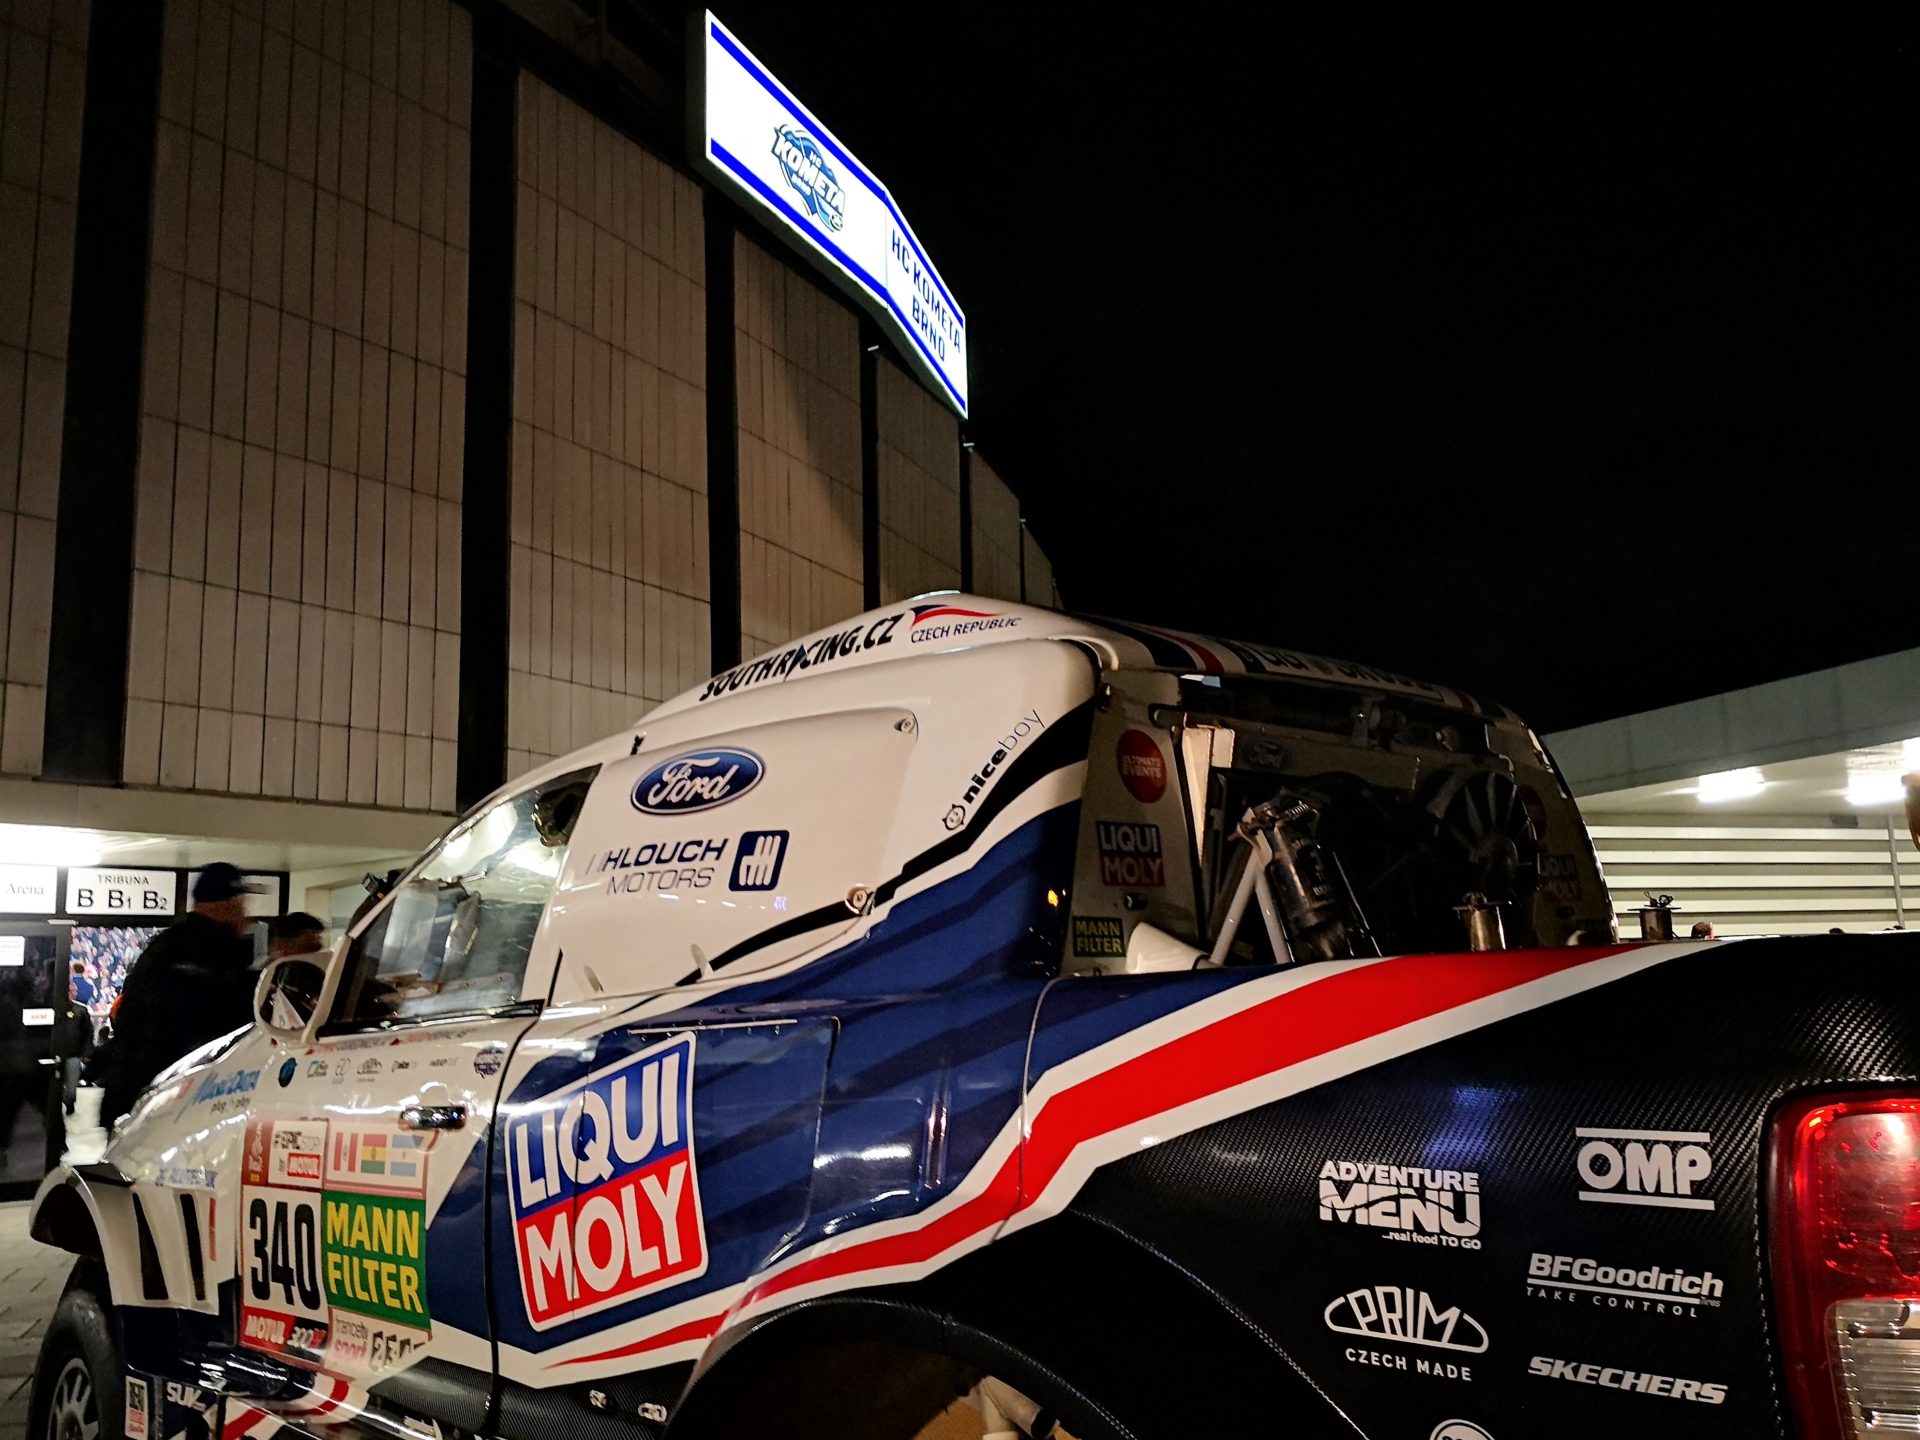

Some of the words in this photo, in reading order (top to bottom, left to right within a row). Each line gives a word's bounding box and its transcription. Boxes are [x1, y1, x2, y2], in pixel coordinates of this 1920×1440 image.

[772, 128, 845, 216] KOMETA
[892, 229, 910, 274] HC
[913, 261, 961, 354] KOMETA
[912, 294, 945, 362] BRNO
[911, 626, 949, 643] CZECH
[953, 617, 1022, 636] REPUBLIC
[963, 709, 1045, 804] niceboy
[648, 757, 739, 806] Ford
[603, 838, 729, 871] HLOUCH
[1100, 824, 1159, 853] LIQUI
[5, 883, 44, 896] Arena
[98, 874, 149, 885] TRIBUNA
[607, 867, 715, 895] MOTORS
[1103, 856, 1162, 885] MOLY
[78, 889, 94, 908] B
[1076, 921, 1120, 937] MANN
[1077, 937, 1123, 953] FILTER
[515, 1052, 680, 1208] LIQUI
[1319, 1160, 1480, 1193] ADVENTURE
[1577, 1141, 1712, 1195] OMP
[327, 1201, 419, 1259] MANN
[1319, 1179, 1481, 1237] MENU
[250, 1198, 320, 1310] 340
[525, 1160, 688, 1312] MOLY
[1412, 1232, 1438, 1245] food
[1440, 1235, 1459, 1247] TO
[1461, 1239, 1481, 1250] GO
[328, 1252, 424, 1313] FILTER
[1528, 1253, 1724, 1297] BFGoodrich
[1346, 1285, 1461, 1343] PRIM
[1526, 1287, 1577, 1302] TAKE
[1592, 1296, 1697, 1318] CONTROL
[1345, 1348, 1407, 1370] CZECH
[1416, 1359, 1472, 1381] MADE
[1528, 1356, 1728, 1404] SKECHERS
